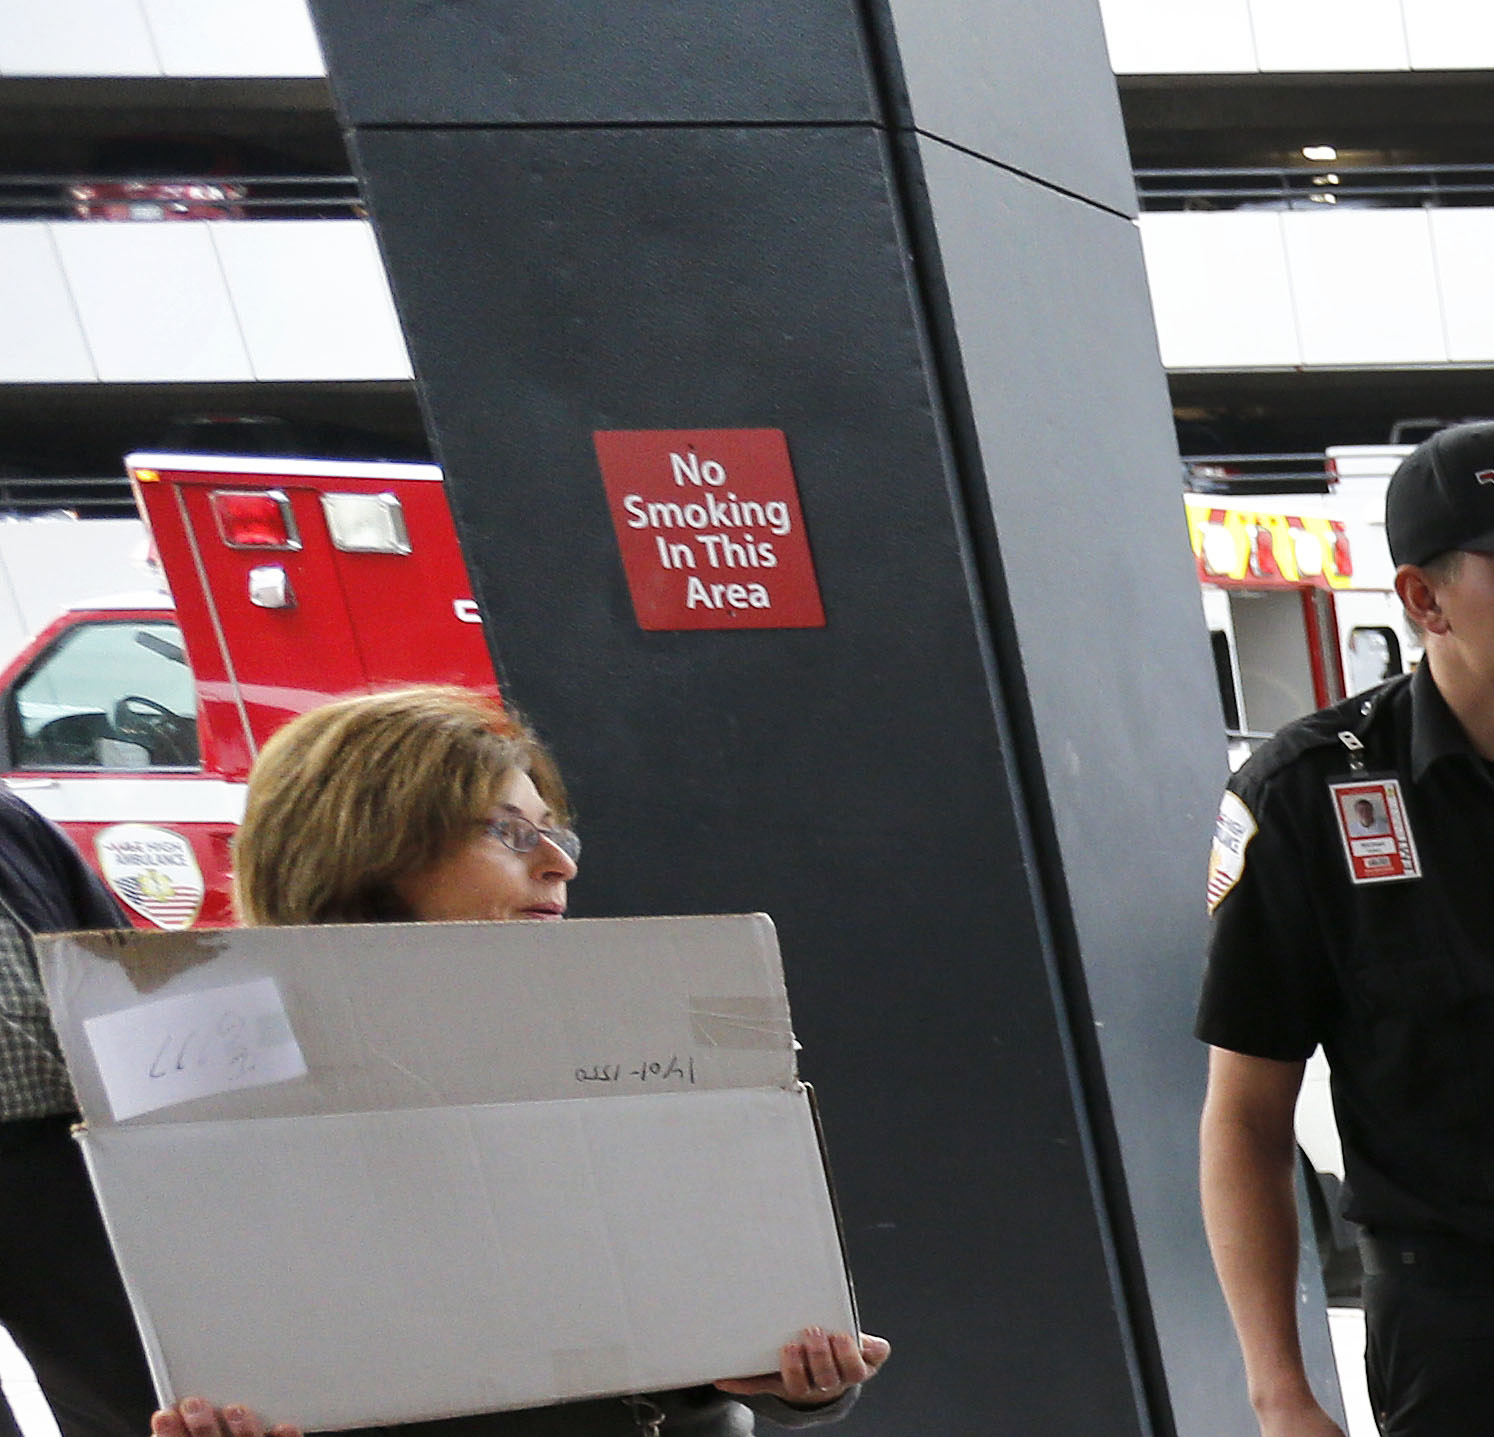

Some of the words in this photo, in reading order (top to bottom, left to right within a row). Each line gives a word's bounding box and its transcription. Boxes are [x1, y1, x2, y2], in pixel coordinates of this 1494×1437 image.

[669, 451, 727, 487] No
[623, 491, 792, 537] Smoking
[656, 535, 696, 569] In
[695, 533, 778, 569] This
[685, 575, 771, 609] Area
